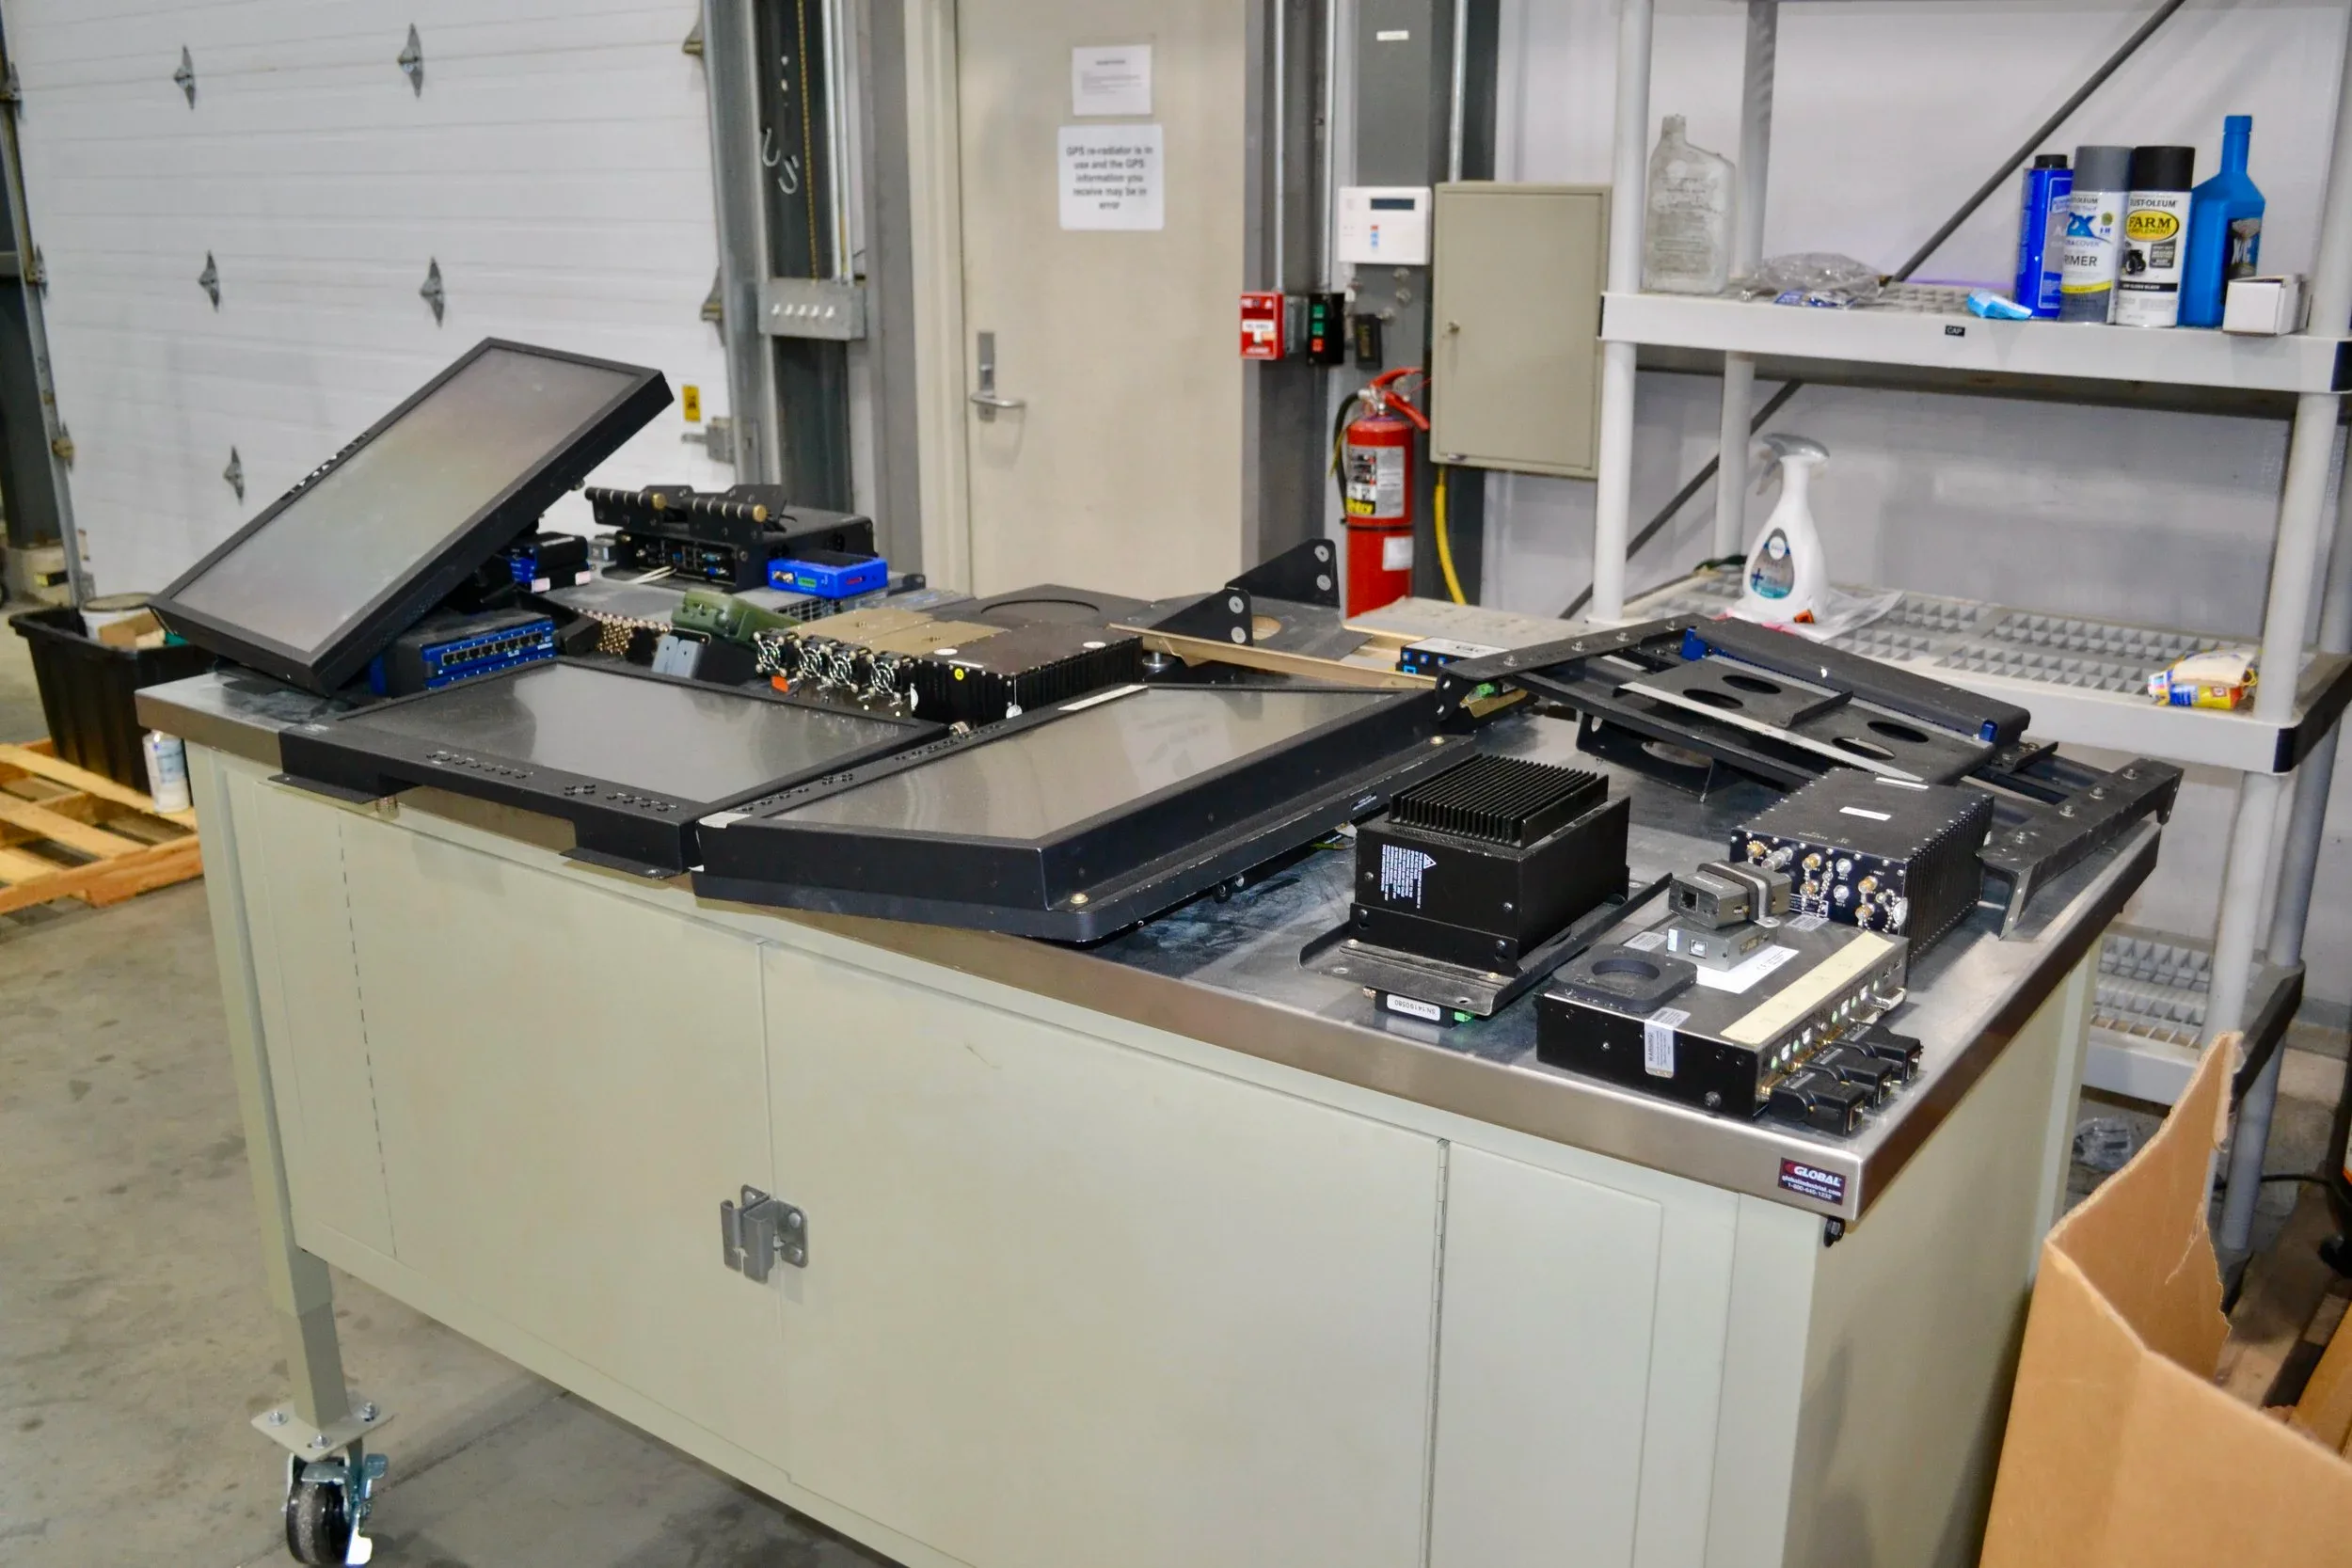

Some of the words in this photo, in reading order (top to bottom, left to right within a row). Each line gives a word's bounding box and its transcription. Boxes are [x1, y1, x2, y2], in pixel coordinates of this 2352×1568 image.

[1066, 146, 1085, 156] GPS
[1087, 146, 1131, 156] re-radiator
[1135, 146, 1142, 155] is
[1144, 146, 1153, 154] in
[1091, 160, 1107, 169] and
[1109, 159, 1122, 169] the
[1125, 159, 1145, 168] GPS
[1075, 173, 1125, 182] information
[1127, 174, 1143, 184] you
[1073, 187, 1103, 197] receive
[1104, 187, 1123, 198] may
[1125, 187, 1136, 197] be
[1138, 187, 1147, 196] in
[1099, 200, 1120, 210] error
[2129, 216, 2171, 228] FARM
[1794, 1166, 1841, 1187] GLOBAL
